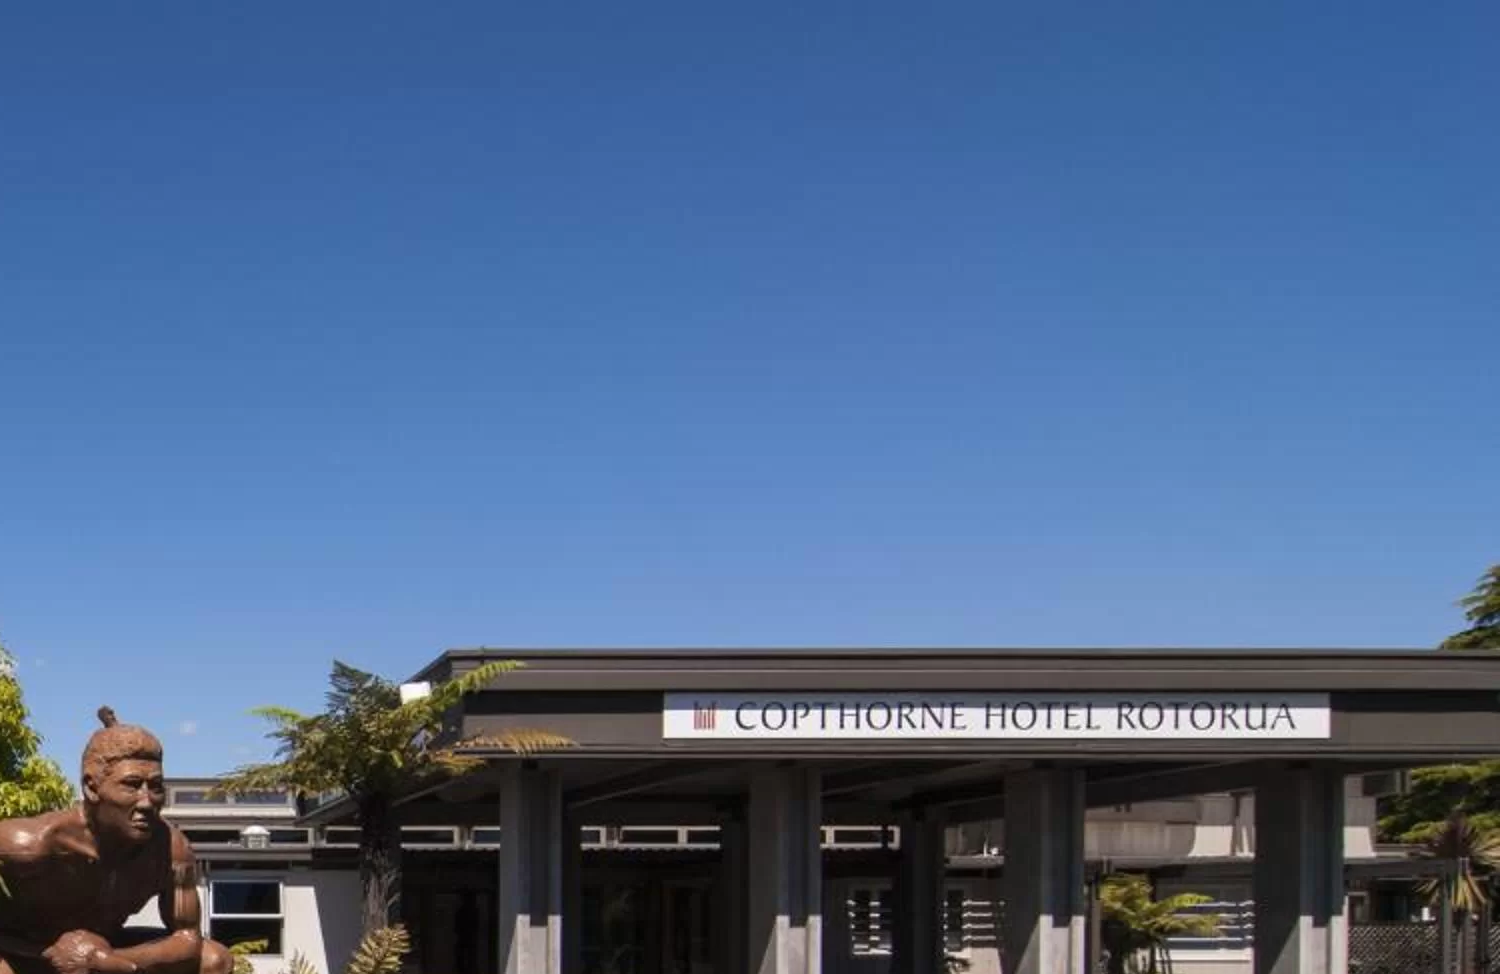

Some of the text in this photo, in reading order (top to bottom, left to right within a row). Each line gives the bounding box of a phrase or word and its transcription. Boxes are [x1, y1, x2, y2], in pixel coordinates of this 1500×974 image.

[735, 700, 1298, 731] COPTHORNE HOTEL ROTORUA
